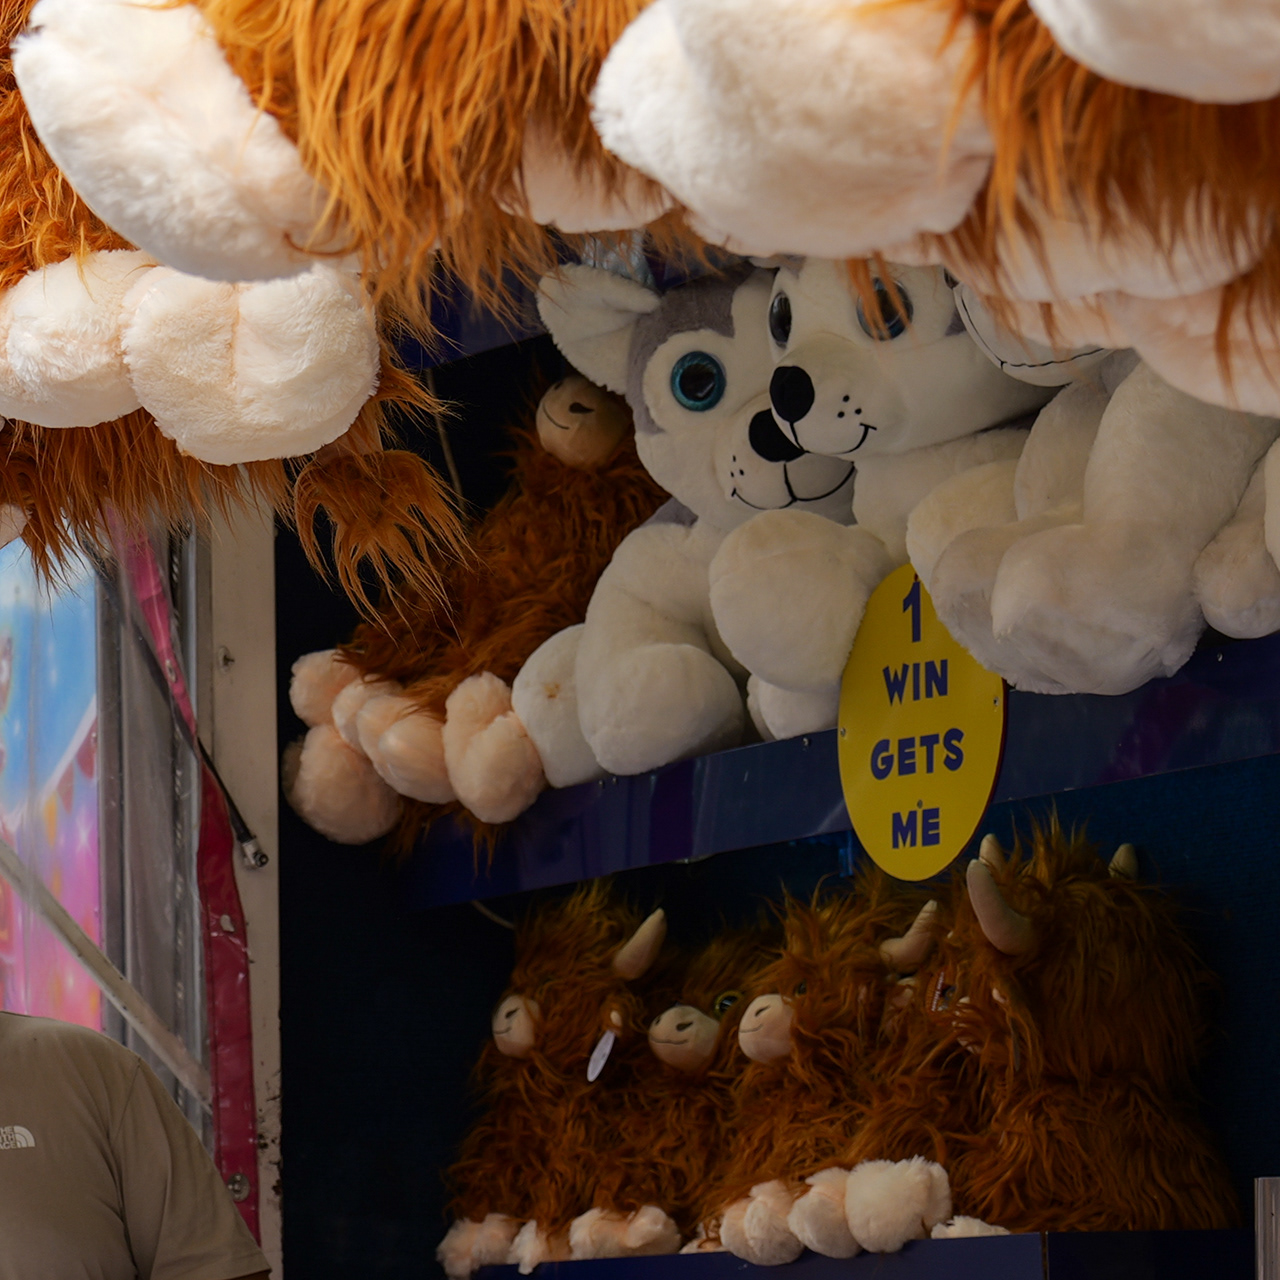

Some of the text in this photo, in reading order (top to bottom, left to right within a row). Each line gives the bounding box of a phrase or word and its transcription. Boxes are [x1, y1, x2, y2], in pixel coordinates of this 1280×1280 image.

[903, 580, 921, 643] 1
[882, 659, 948, 706] WIN
[870, 728, 965, 780] GETS
[892, 807, 940, 849] ME
